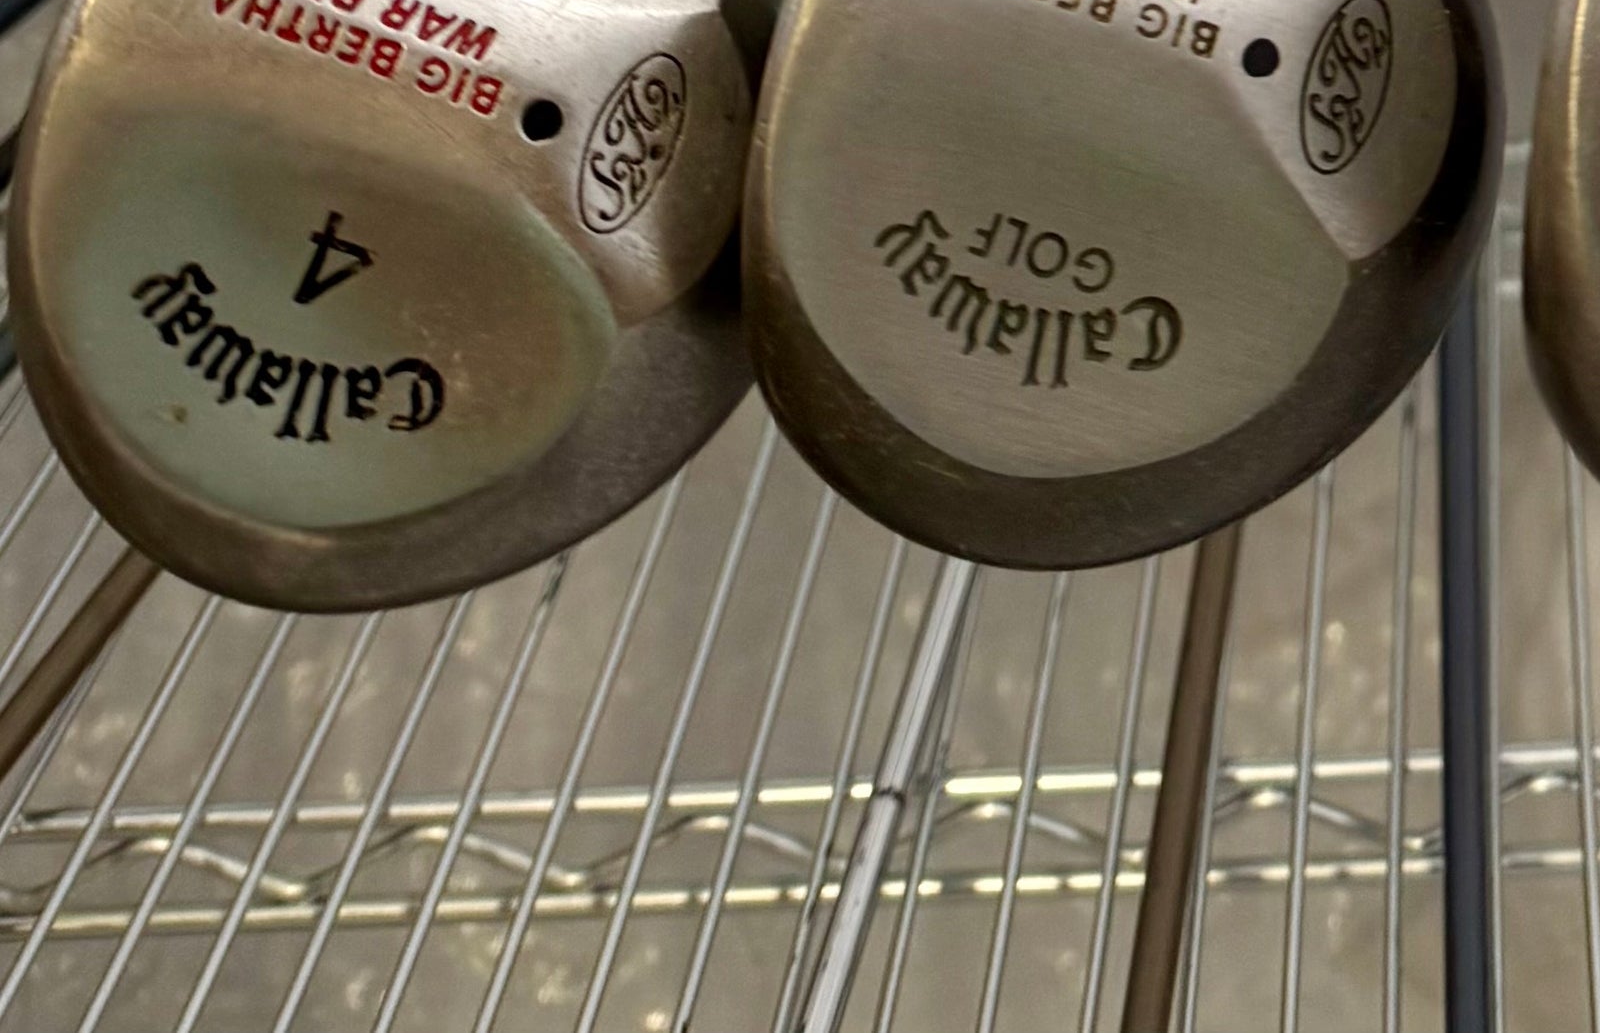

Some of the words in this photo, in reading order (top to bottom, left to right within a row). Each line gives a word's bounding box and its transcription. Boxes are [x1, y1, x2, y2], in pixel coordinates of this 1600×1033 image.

[1135, 3, 1221, 60] BIG
[415, 55, 504, 116] BIG
[293, 210, 376, 304] 4
[967, 212, 1116, 294] GOLF
[874, 209, 1184, 388] Callaway
[131, 261, 446, 443] Callaway
